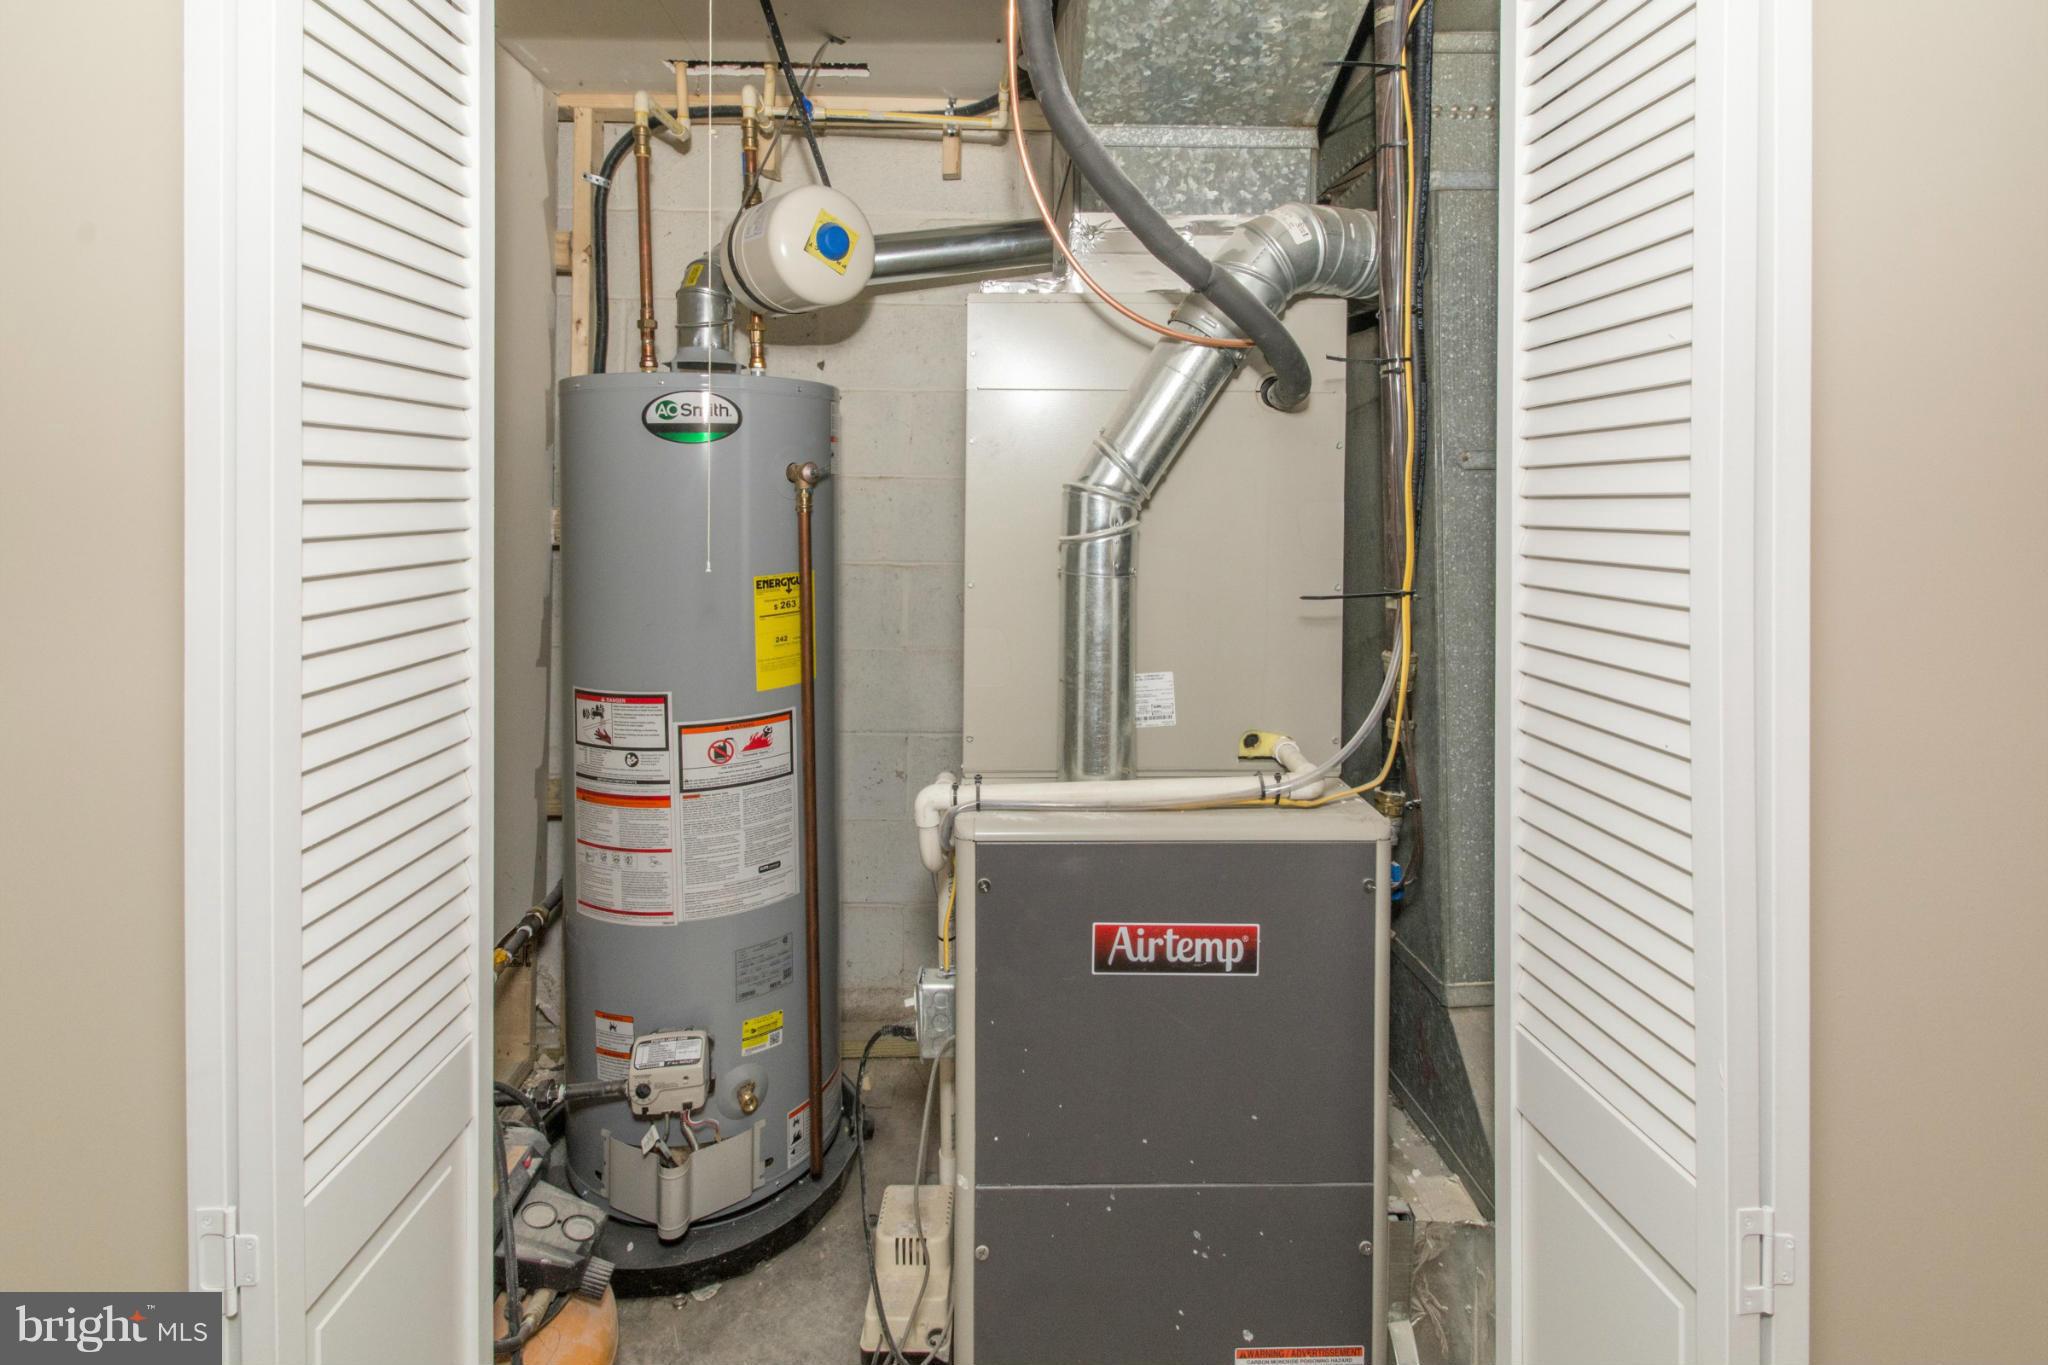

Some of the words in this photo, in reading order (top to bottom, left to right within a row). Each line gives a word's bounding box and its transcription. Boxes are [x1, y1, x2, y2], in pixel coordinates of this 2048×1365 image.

[680, 402, 729, 417] Smith
[780, 599, 797, 609] 263
[1248, 1349, 1284, 1359] WARNING
